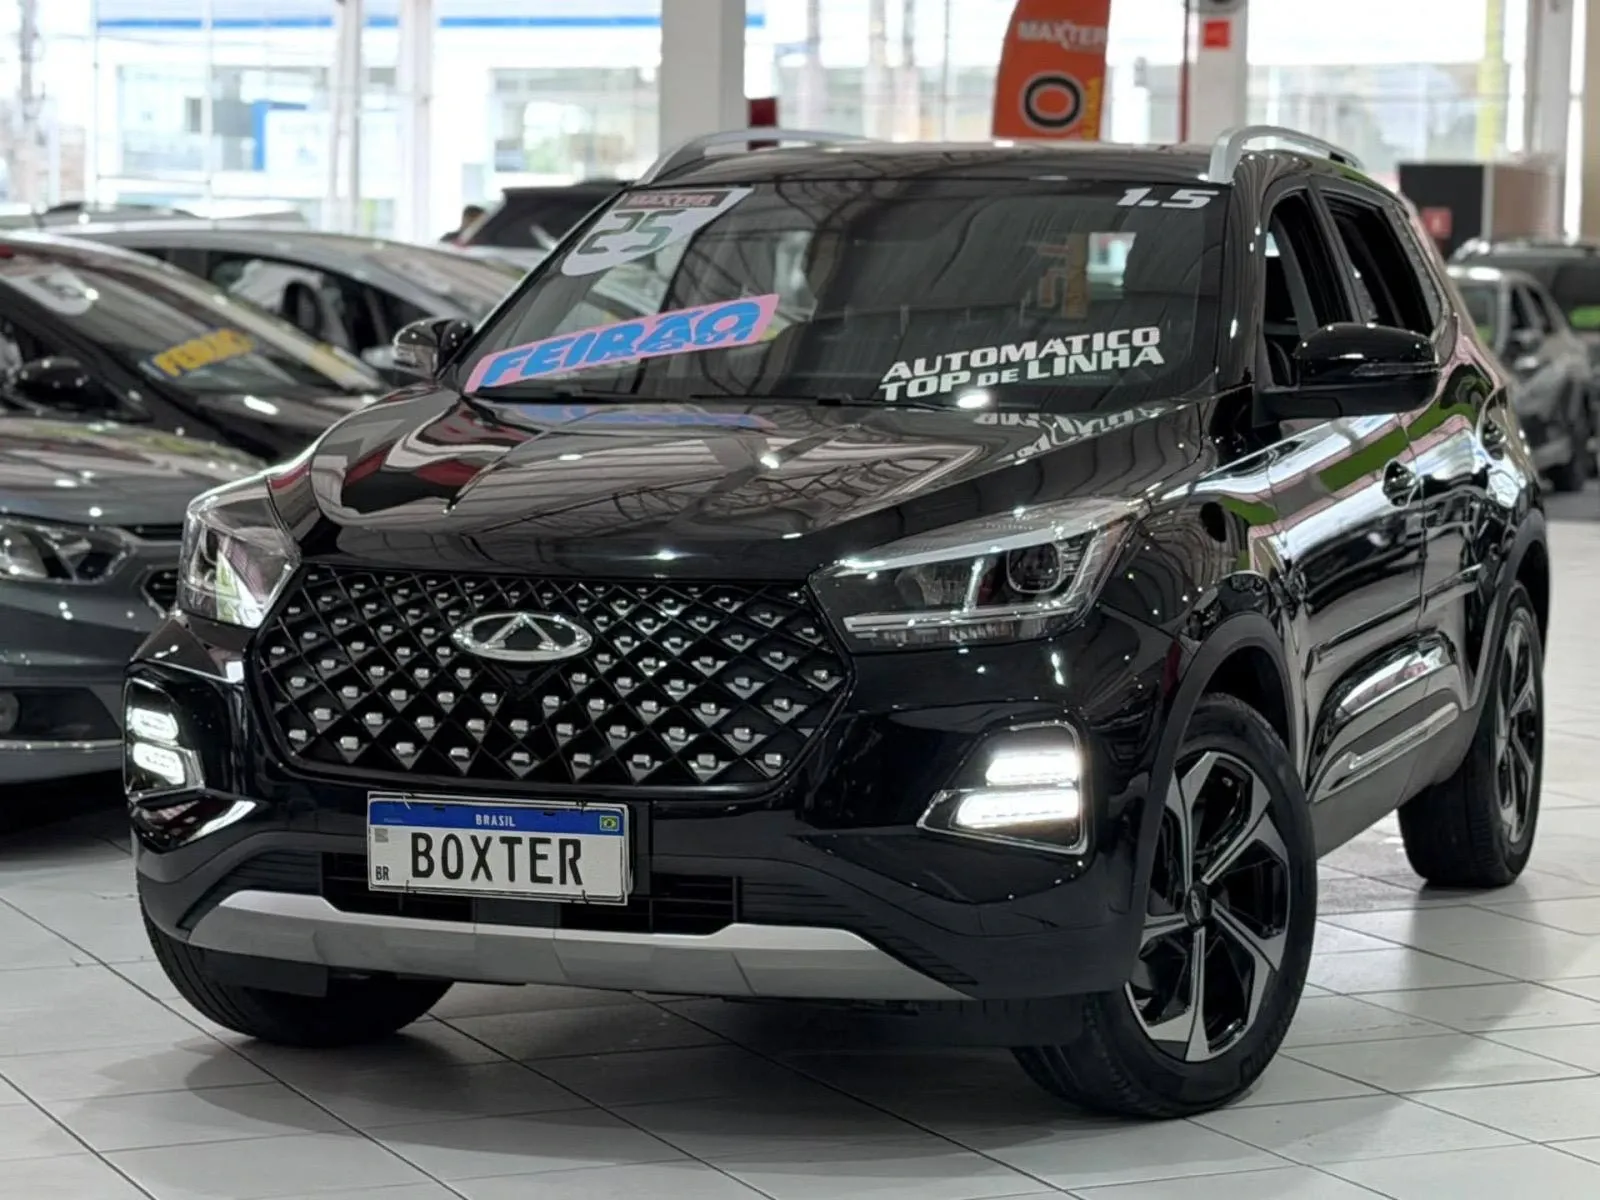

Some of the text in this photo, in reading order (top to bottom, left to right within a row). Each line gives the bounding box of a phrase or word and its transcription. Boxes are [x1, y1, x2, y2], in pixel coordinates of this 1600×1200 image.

[1116, 187, 1220, 209] 1.5
[577, 209, 686, 255] 25
[879, 346, 1165, 401] TOP DE LINHA
[475, 814, 516, 827] BRASIL
[375, 865, 390, 881] BR
[411, 832, 583, 885] BOXTER
